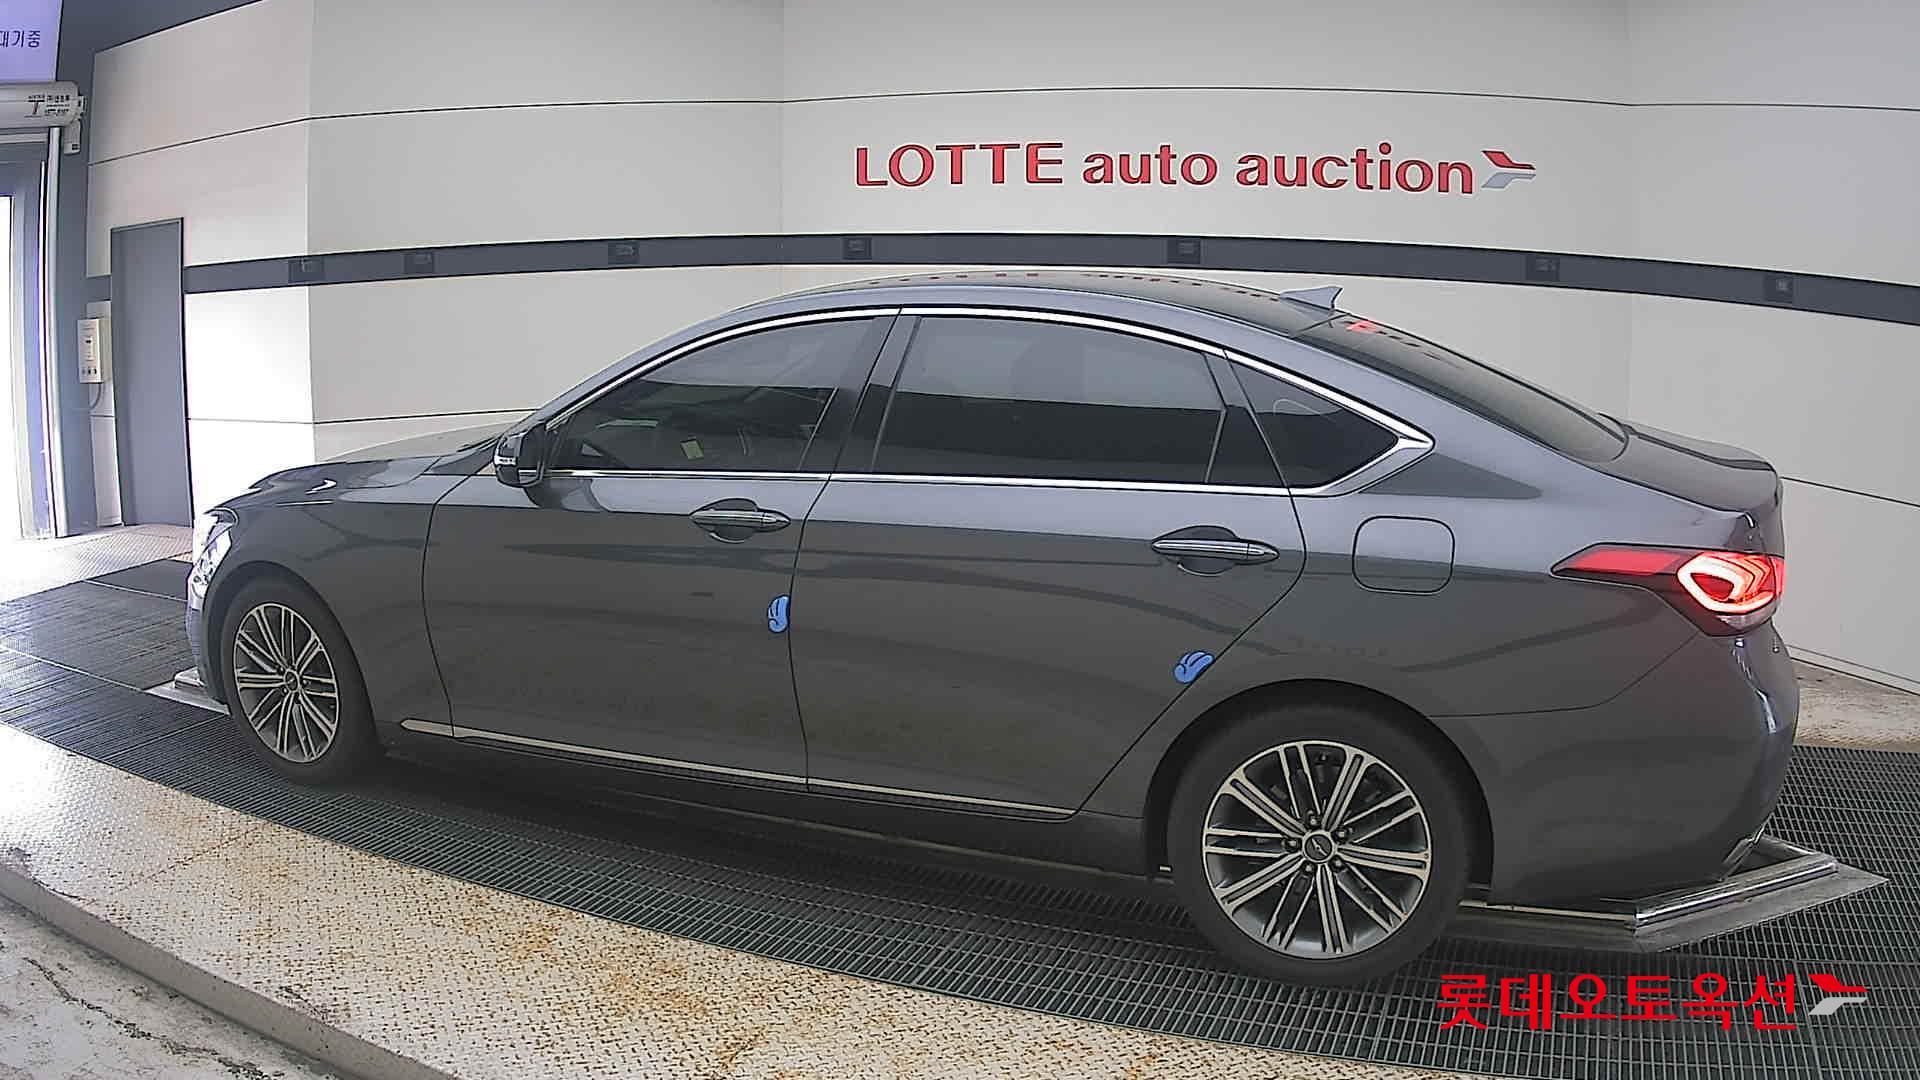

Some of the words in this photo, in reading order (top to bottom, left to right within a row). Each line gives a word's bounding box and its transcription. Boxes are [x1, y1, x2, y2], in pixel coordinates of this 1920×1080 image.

[855, 142, 1064, 188] LOTTE
[1082, 145, 1218, 186] auto
[1236, 142, 1474, 195] auction
